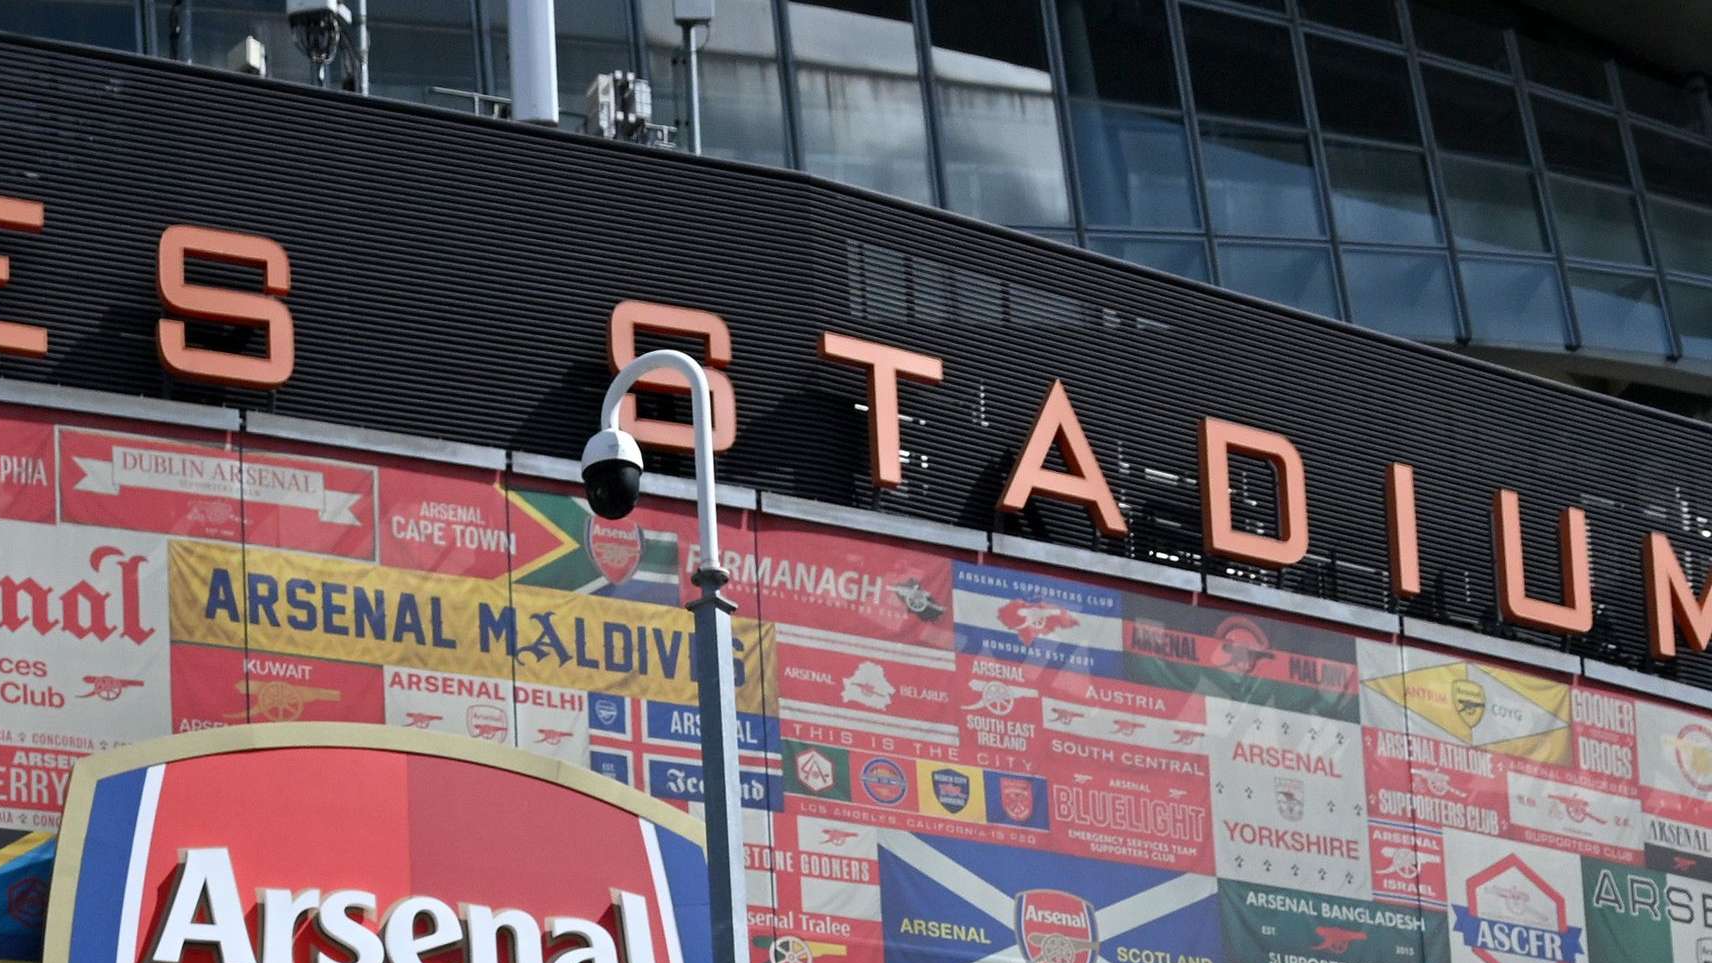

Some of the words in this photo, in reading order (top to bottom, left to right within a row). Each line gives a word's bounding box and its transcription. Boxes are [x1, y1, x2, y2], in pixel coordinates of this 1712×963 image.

[420, 501, 486, 528] ARSENAL
[392, 516, 447, 545] CAPE
[452, 522, 518, 556] TOWN
[242, 658, 312, 682] KUWAIT
[972, 660, 1025, 682] ARSENAL
[0, 675, 66, 709] Club
[390, 672, 509, 701] ARSENAL
[512, 685, 584, 714] DELHI
[1085, 687, 1167, 712] AUSTRIA
[966, 714, 1006, 736] SOUTH
[1002, 721, 1036, 739] EAST
[793, 723, 855, 745] THIS
[871, 737, 896, 750] IS
[912, 743, 960, 763] THE
[977, 754, 1034, 772] CITY
[976, 730, 1028, 752] IRELAND
[1051, 738, 1116, 763] SOUTH
[1120, 748, 1206, 776] CENTRAL
[1232, 740, 1343, 779] ARSENAL
[1109, 778, 1151, 793] ARSENAL
[1222, 819, 1361, 861] YORKSHIRE
[1372, 827, 1440, 851] ARSENAL
[1383, 879, 1437, 897] ISRAEL
[798, 912, 851, 938] Tralee
[1246, 890, 1318, 916] ARSENAL
[1321, 904, 1426, 933] BANGLADESH
[900, 917, 992, 944] ARSENAL
